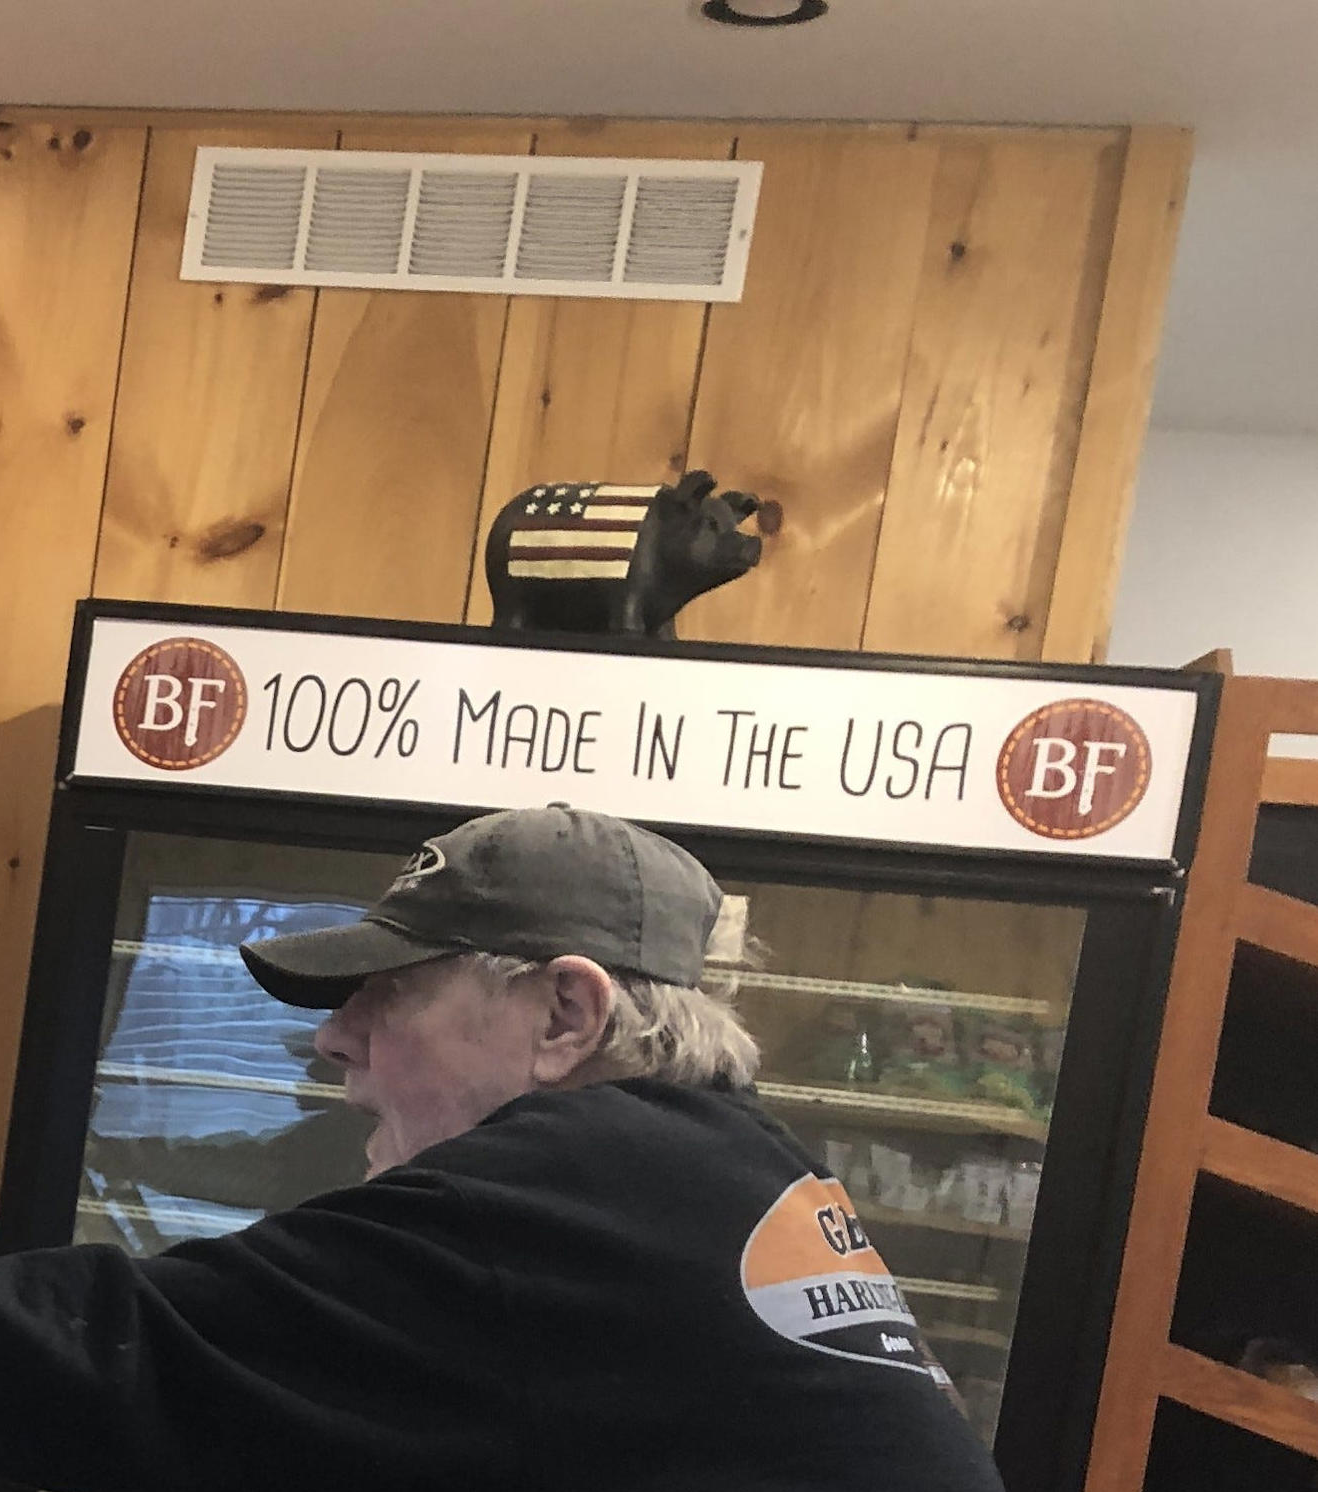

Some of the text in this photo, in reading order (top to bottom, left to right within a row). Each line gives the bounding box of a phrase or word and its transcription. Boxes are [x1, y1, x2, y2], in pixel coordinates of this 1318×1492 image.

[137, 672, 1127, 817] BF 100% MADE IN THE USA BF
